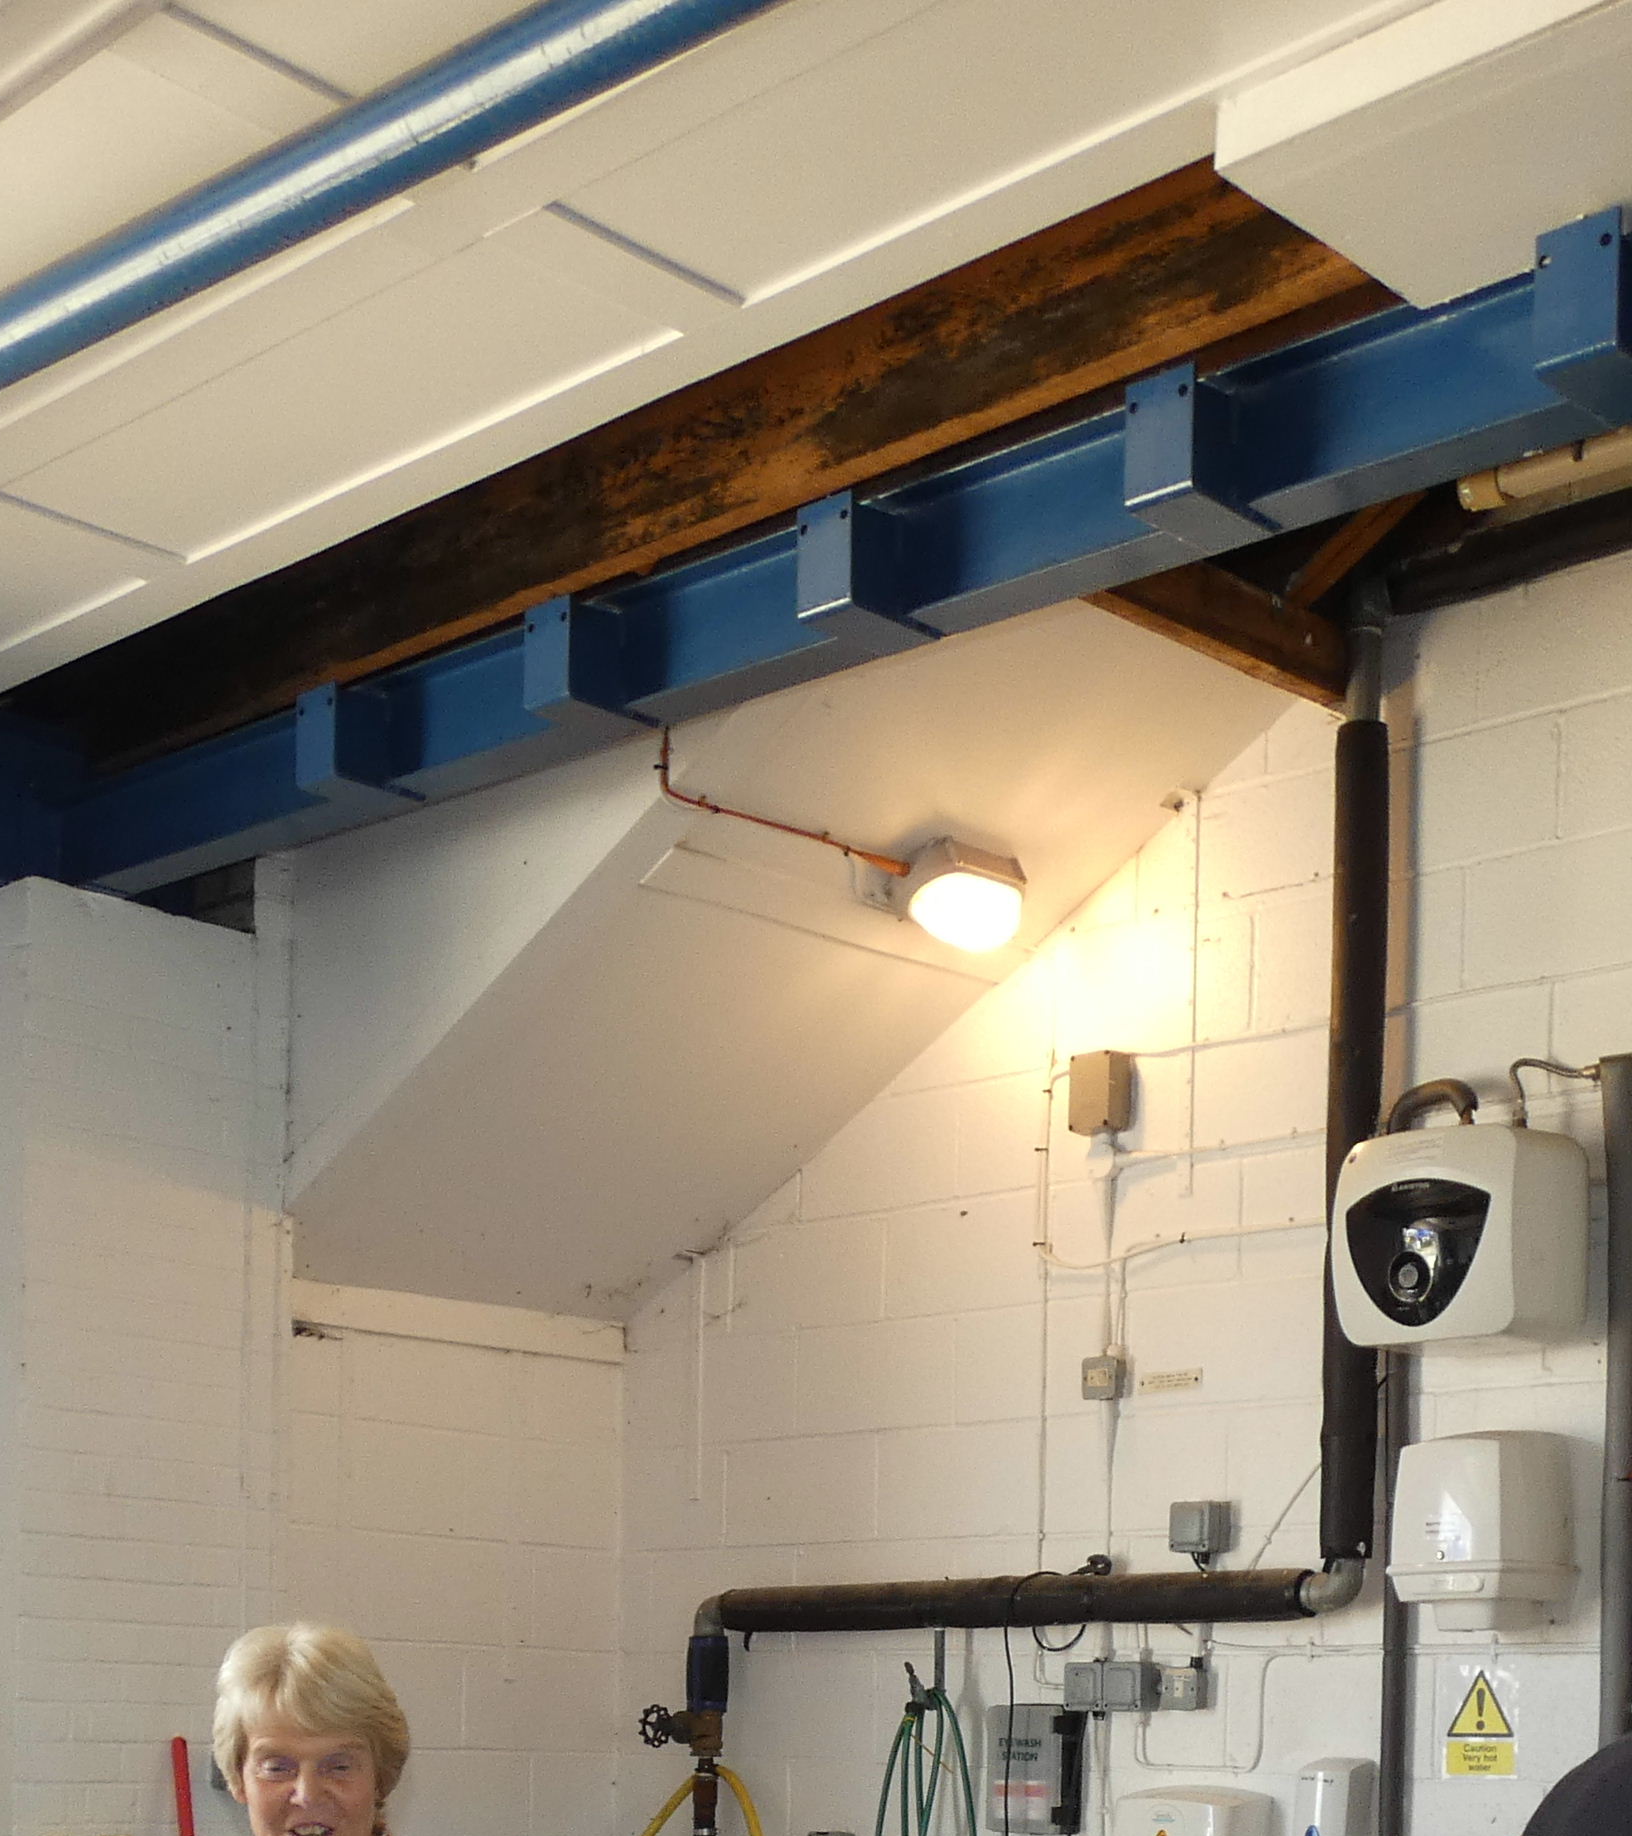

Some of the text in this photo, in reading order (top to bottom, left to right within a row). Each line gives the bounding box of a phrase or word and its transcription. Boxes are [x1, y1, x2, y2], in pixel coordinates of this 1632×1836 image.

[1463, 1743, 1498, 1754] Caution
[1462, 1753, 1498, 1765] Very hot
[1468, 1763, 1492, 1772] water
